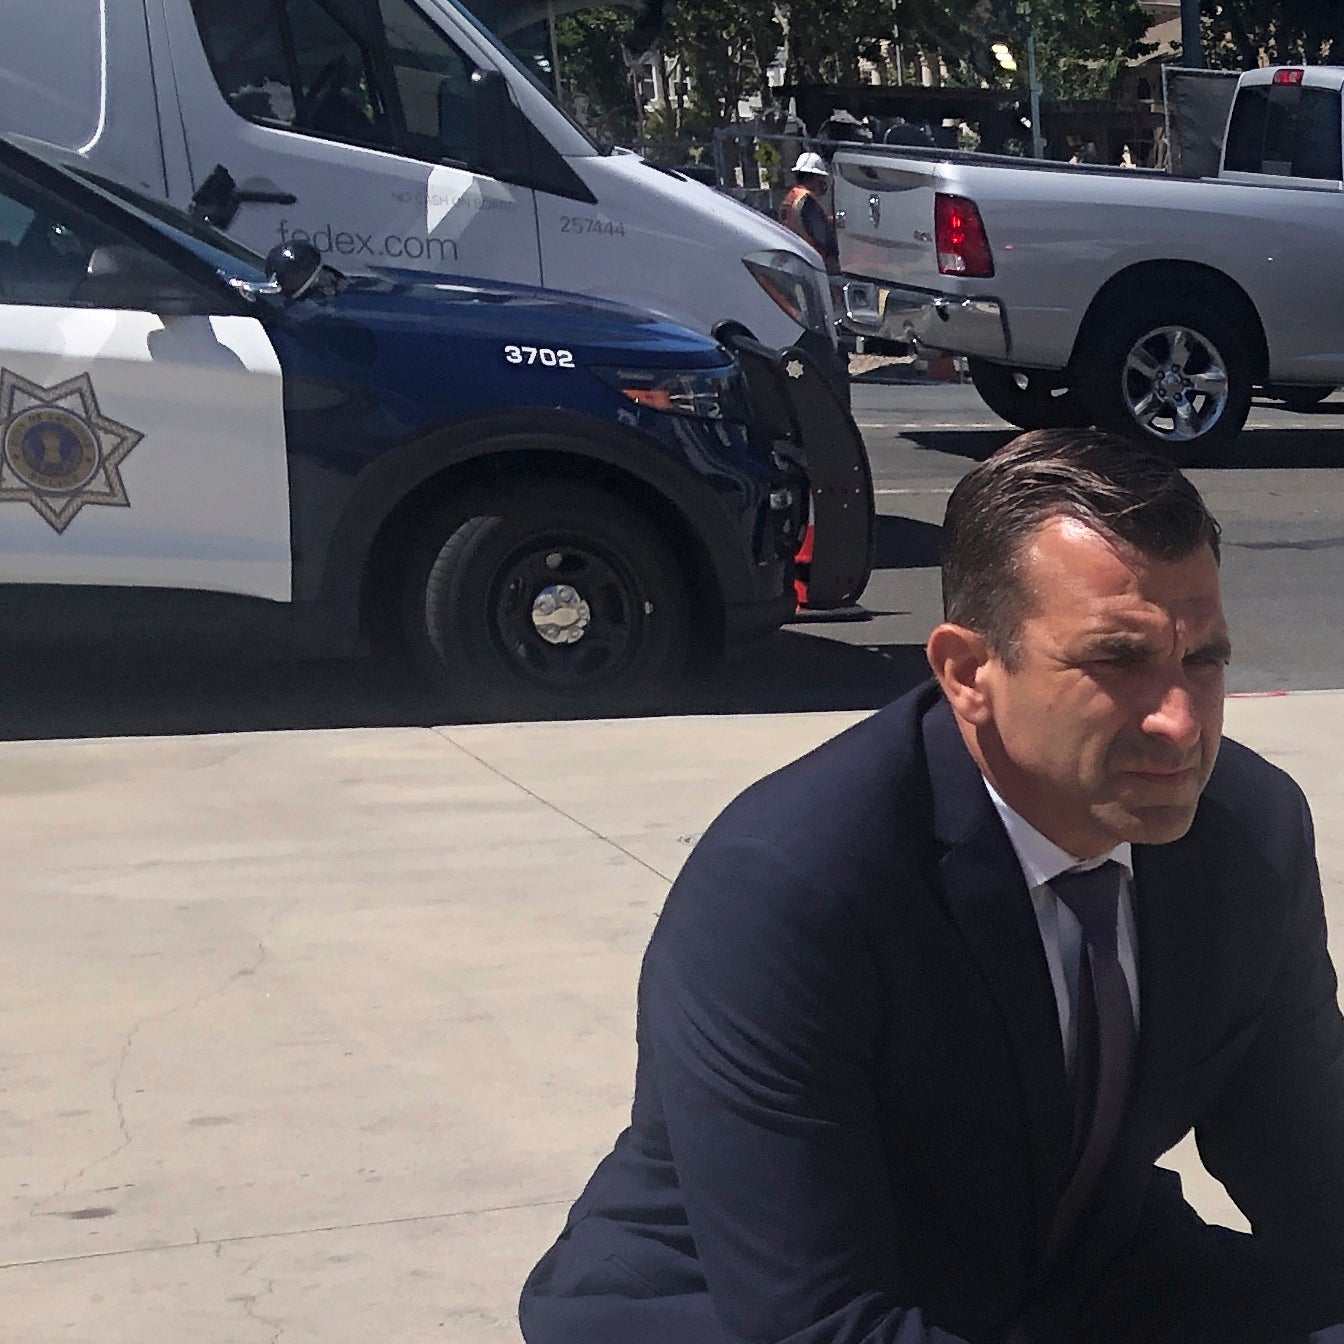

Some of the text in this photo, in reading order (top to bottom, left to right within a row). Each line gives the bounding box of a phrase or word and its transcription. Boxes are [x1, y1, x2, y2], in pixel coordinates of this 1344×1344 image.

[560, 216, 625, 238] 257444
[276, 220, 459, 261] fedex.com
[504, 345, 576, 368] 3702
